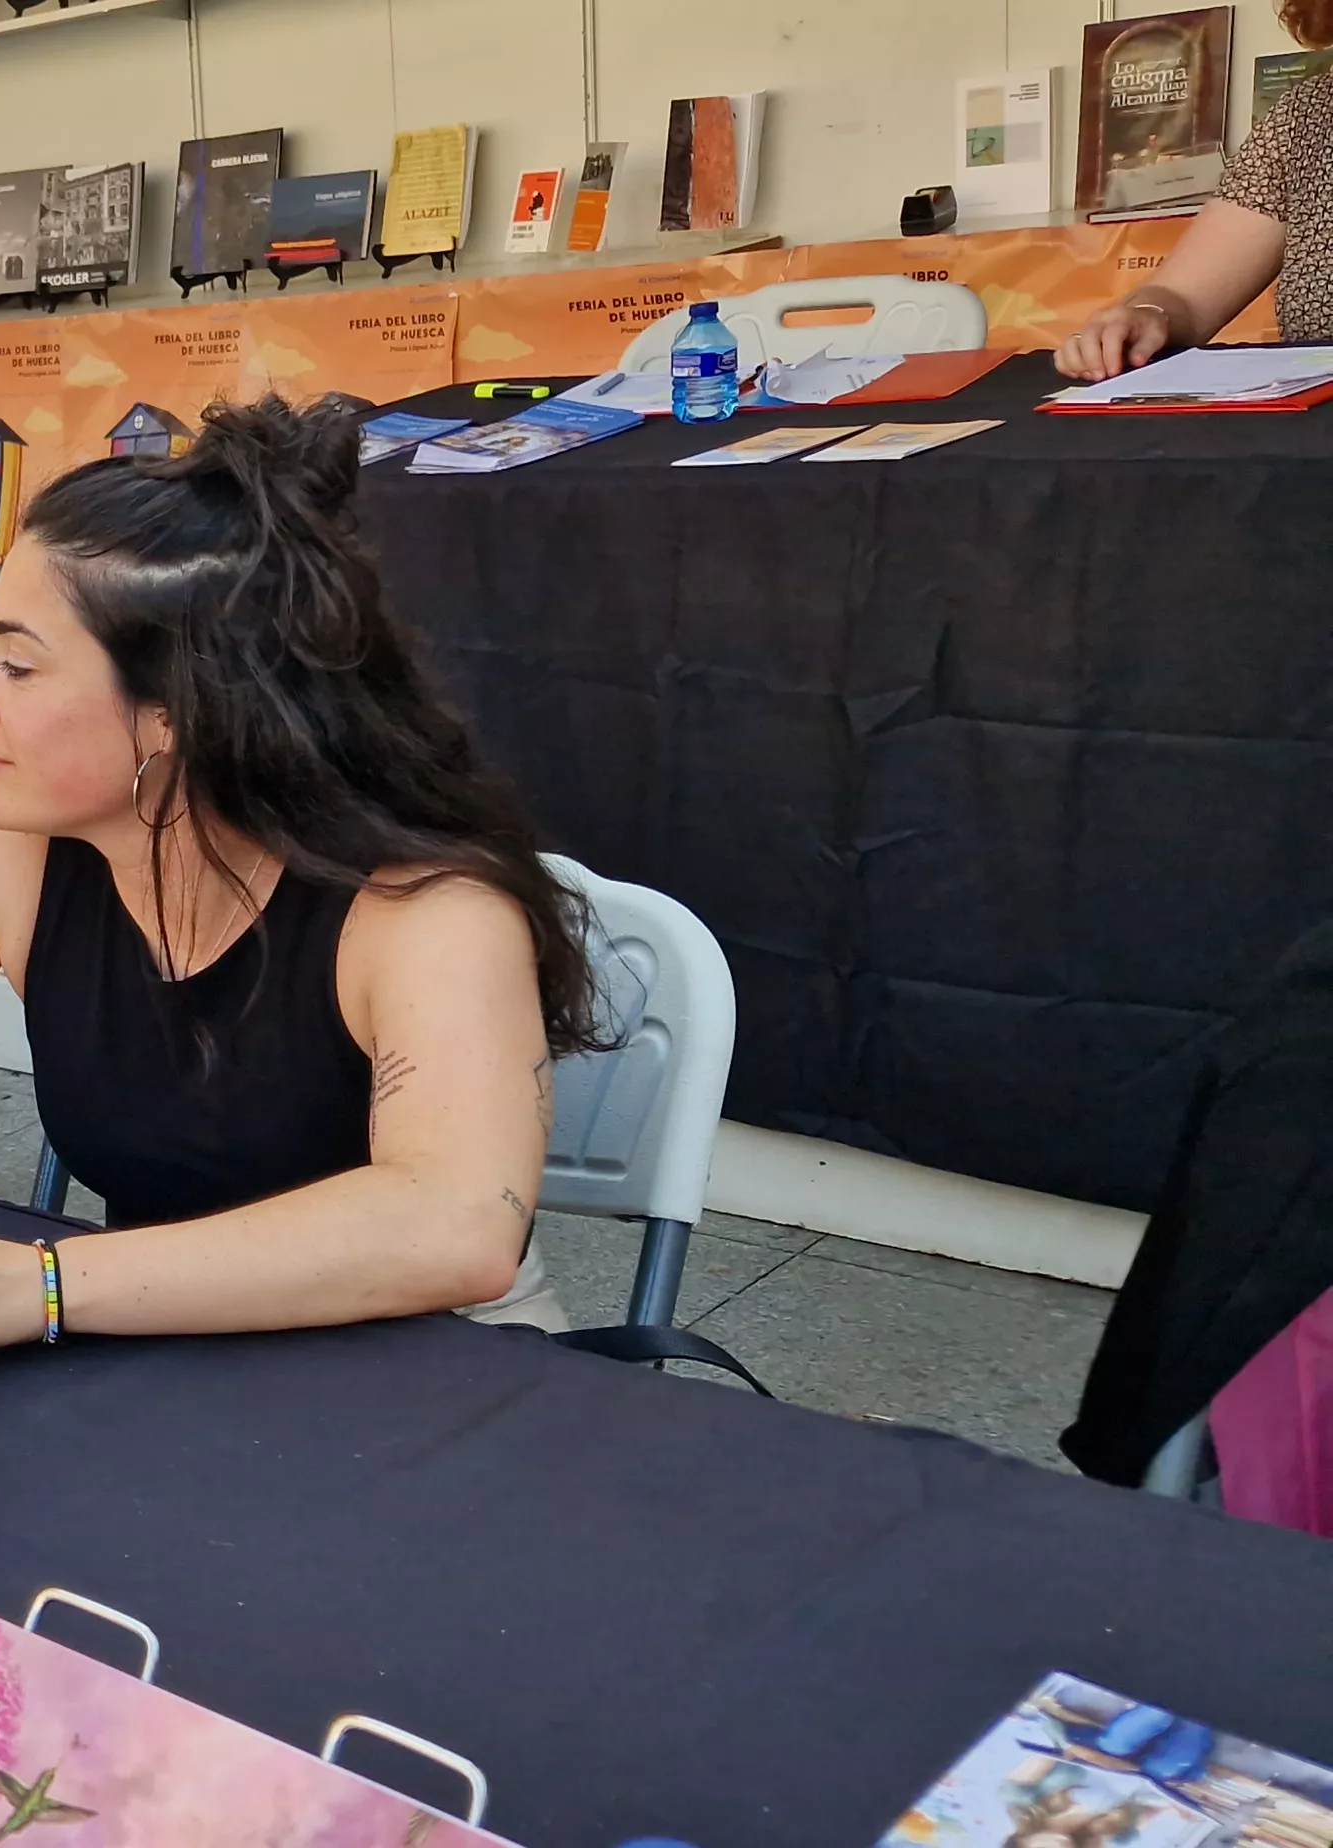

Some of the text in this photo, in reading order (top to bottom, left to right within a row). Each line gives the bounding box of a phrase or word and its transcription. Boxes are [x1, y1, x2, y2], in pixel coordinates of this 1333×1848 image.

[1111, 66, 1189, 90] enigma
[1160, 80, 1188, 93] Juan
[402, 206, 452, 221] ALAZET
[1117, 255, 1166, 270] FERIA
[903, 270, 949, 282] IBRO
[569, 292, 685, 312] FERIA DEL LIBRO
[349, 312, 445, 330] FERIA DEL LIBRO
[609, 306, 682, 323] DE HUESC
[154, 330, 241, 345] FERIA DEL LIBRO
[382, 327, 445, 341] DE HUESCA
[15, 346, 31, 355] DEL
[34, 344, 61, 354] LIBRO
[181, 343, 240, 356] DE HUESCA
[12, 356, 61, 368] DE HUESCA
